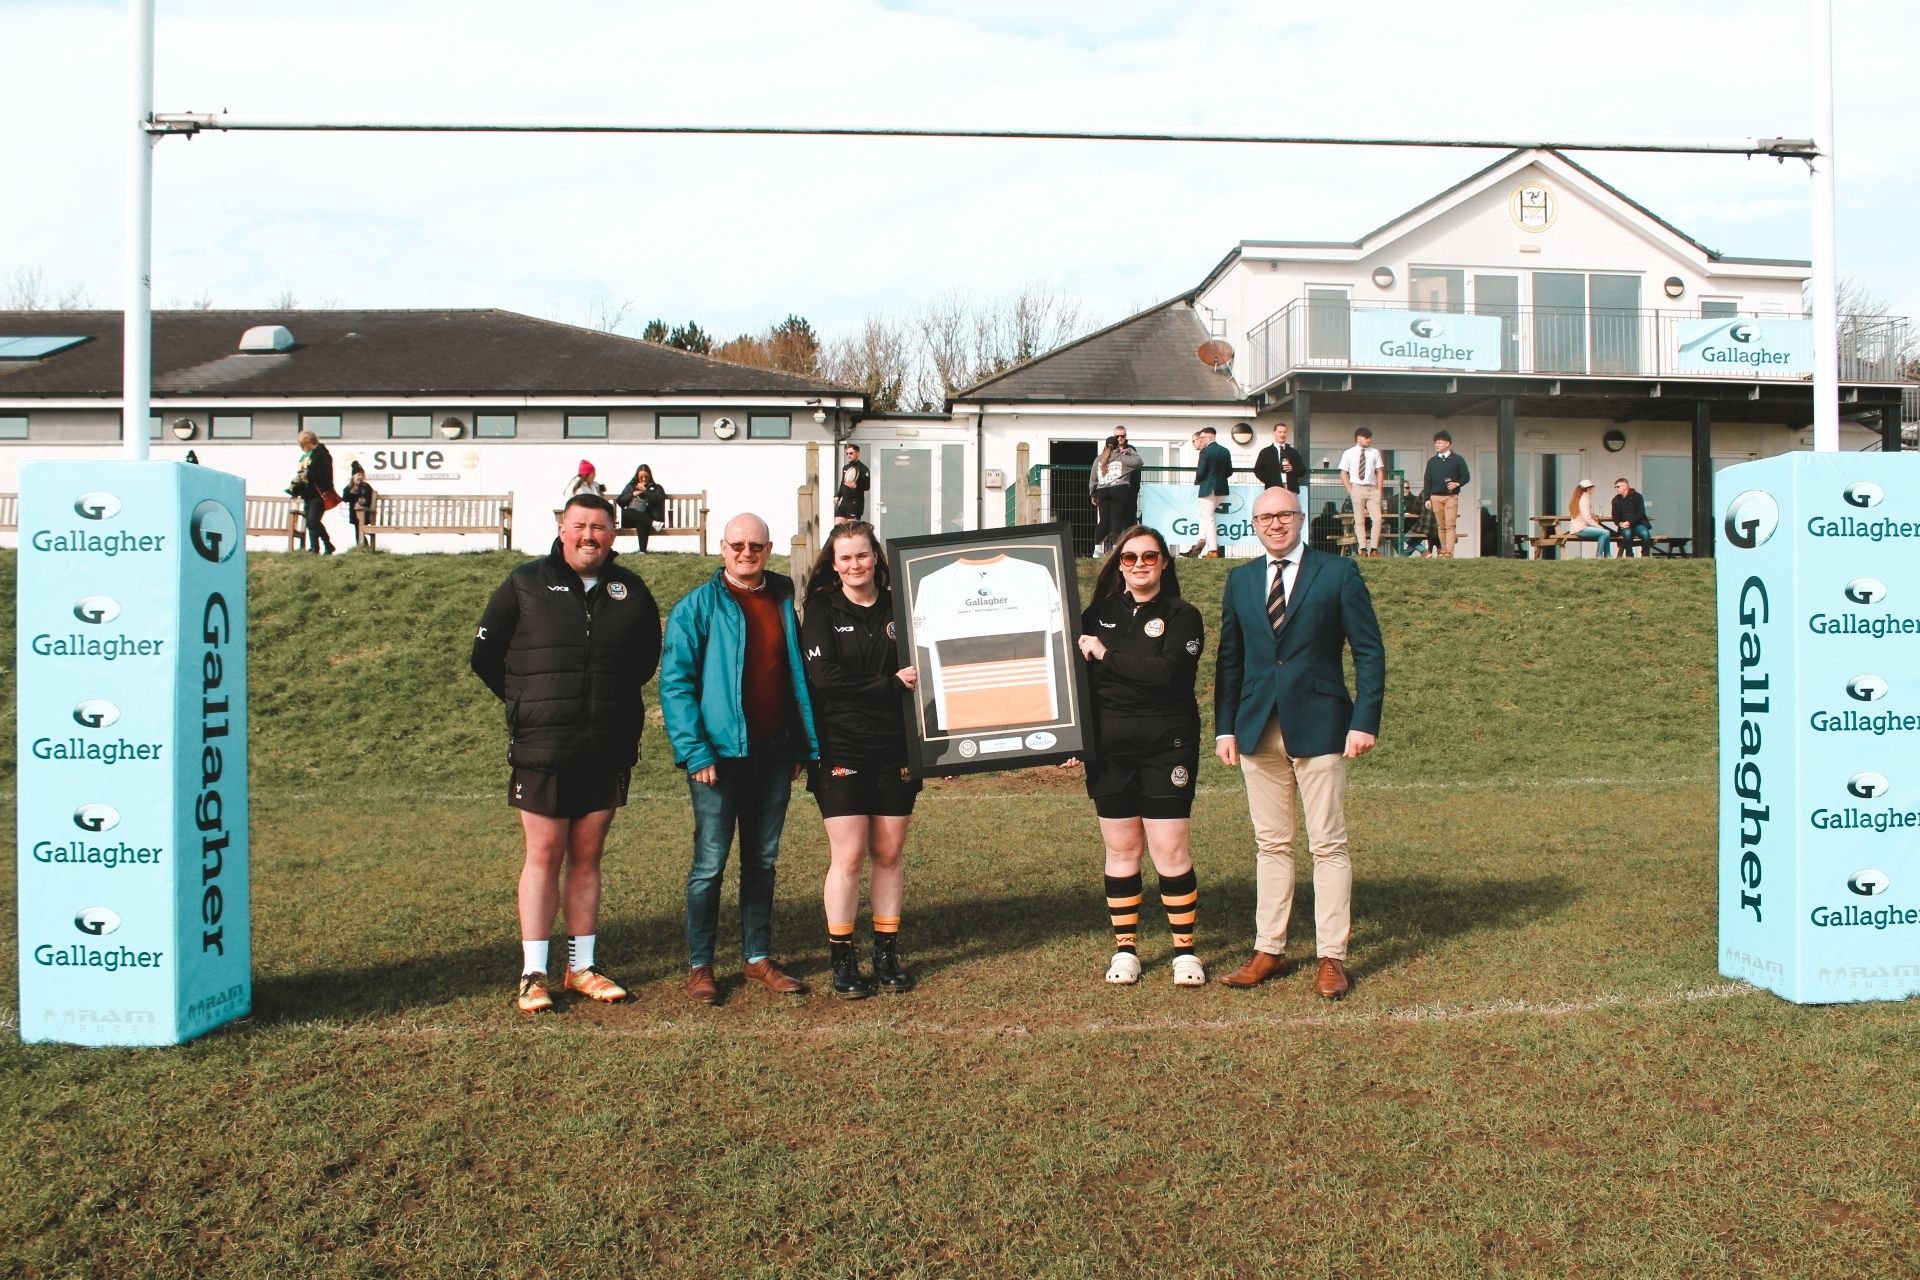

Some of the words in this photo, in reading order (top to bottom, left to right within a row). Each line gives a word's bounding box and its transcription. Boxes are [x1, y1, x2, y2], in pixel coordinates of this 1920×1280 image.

[1380, 341, 1474, 362] Gallagher
[1702, 347, 1790, 366] Gallagher
[374, 451, 444, 470] sure
[32, 530, 165, 557] Gallagher
[965, 597, 1008, 607] Gallagher
[32, 634, 164, 661] Gallagher
[32, 737, 163, 764] Gallagher
[1734, 575, 1769, 922] Gallagher
[195, 591, 229, 956] Gallagher
[1811, 807, 1920, 832] Gallaghe
[33, 841, 163, 868] Gallagher
[1811, 904, 1920, 929] Gallaghe
[34, 944, 163, 971] Gallagher
